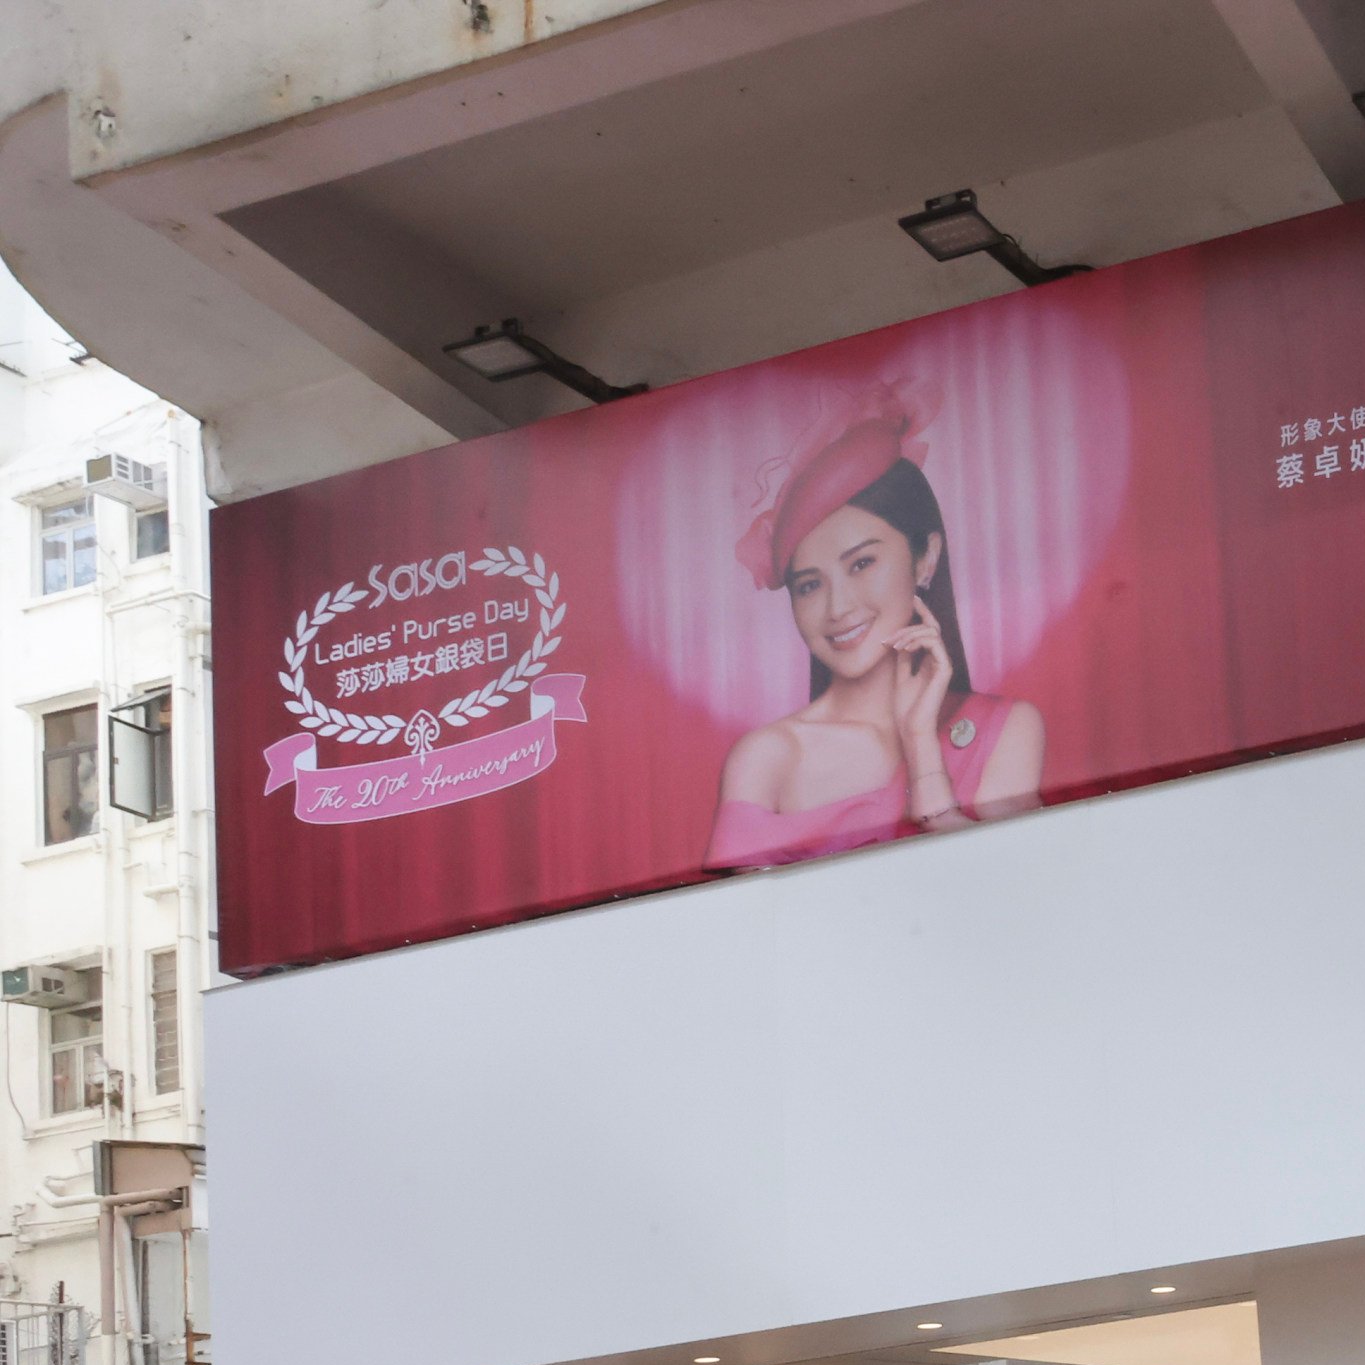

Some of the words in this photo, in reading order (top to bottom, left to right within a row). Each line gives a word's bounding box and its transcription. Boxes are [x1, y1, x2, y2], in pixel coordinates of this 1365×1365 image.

[315, 624, 396, 665] Ladies'
[403, 612, 477, 644] Purse
[484, 598, 529, 623] Day
[336, 632, 508, 698] 莎莎婦女銀袋日
[307, 787, 347, 813] The
[351, 772, 409, 810] 20th
[412, 736, 546, 801] Anniversary
